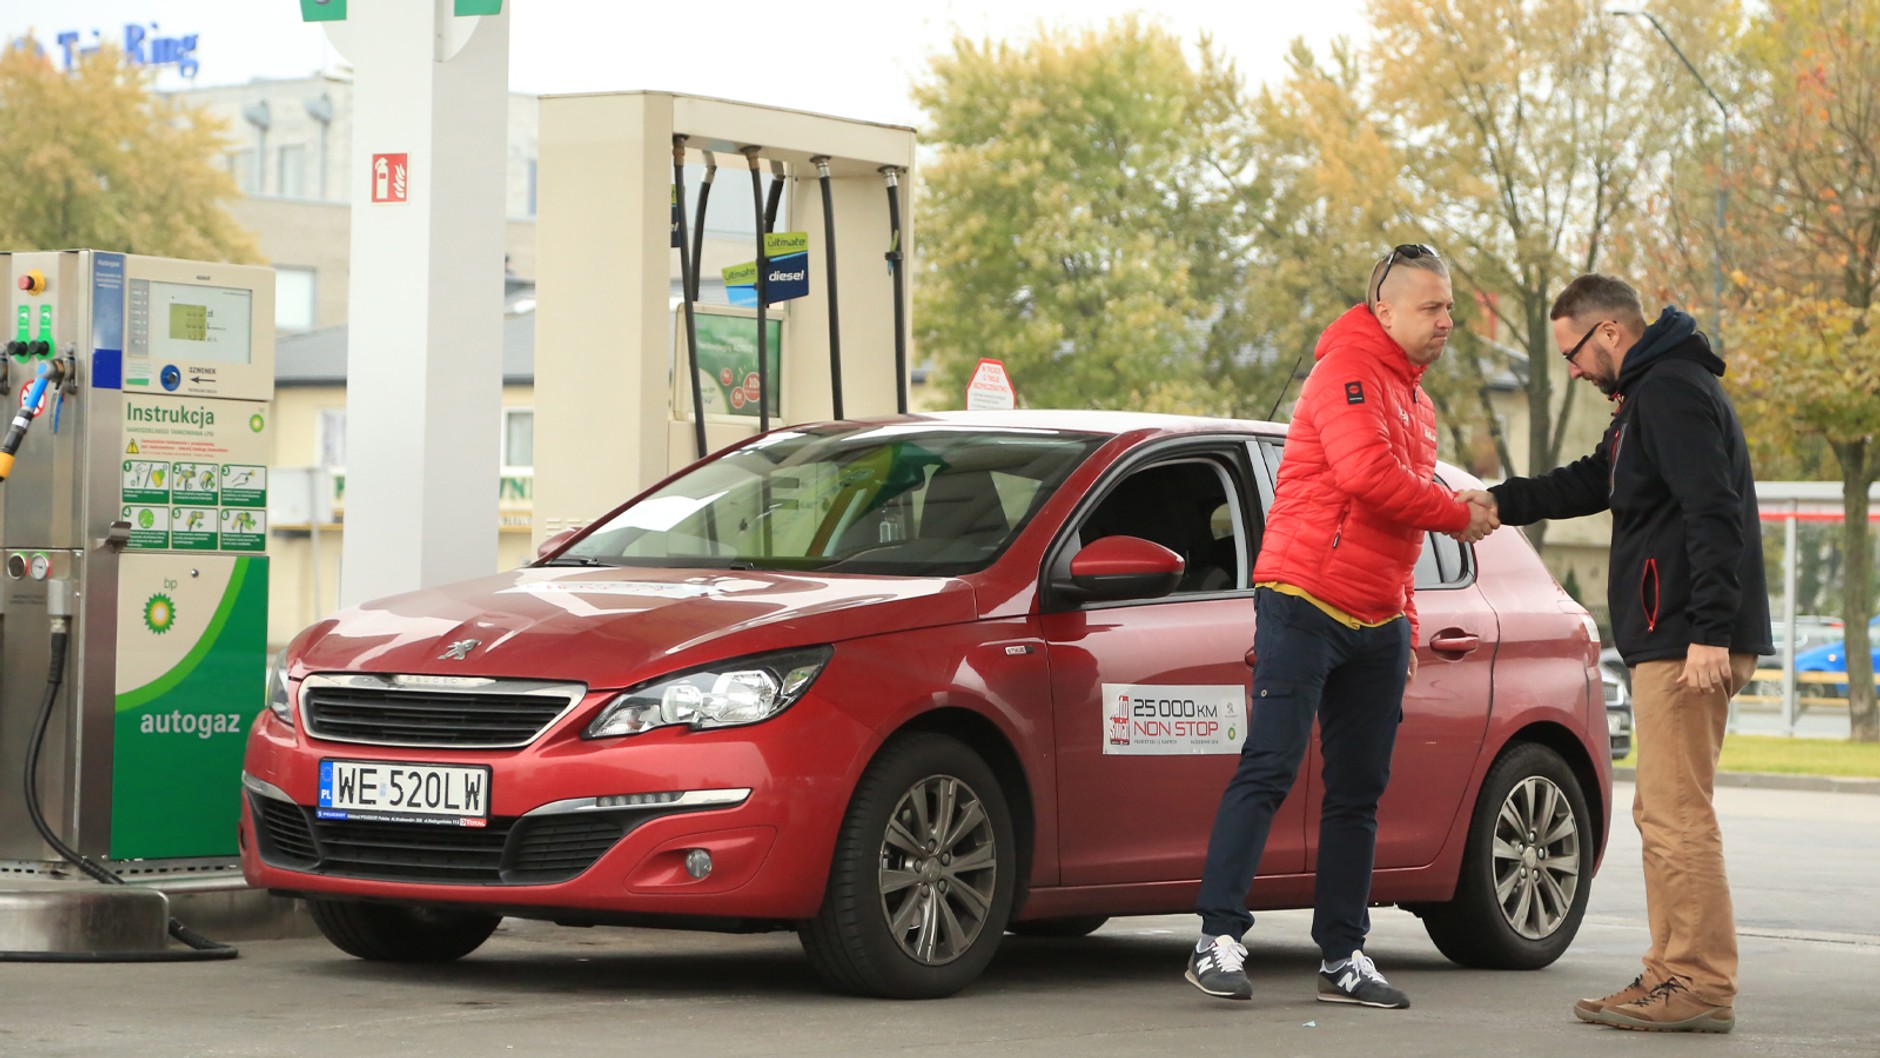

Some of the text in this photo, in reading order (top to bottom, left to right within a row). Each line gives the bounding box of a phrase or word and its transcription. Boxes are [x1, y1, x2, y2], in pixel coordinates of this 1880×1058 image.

[124, 22, 198, 78] Ring
[768, 269, 805, 282] diesel
[127, 402, 215, 428] Instrukcja
[164, 578, 177, 591] bp
[1133, 699, 1218, 717] 25 000 KM
[140, 710, 241, 739] autogaz
[1133, 721, 1219, 737] NON STOP
[321, 789, 332, 800] PL
[338, 767, 481, 811] WE 520LW
[467, 819, 487, 827] TOTAL
